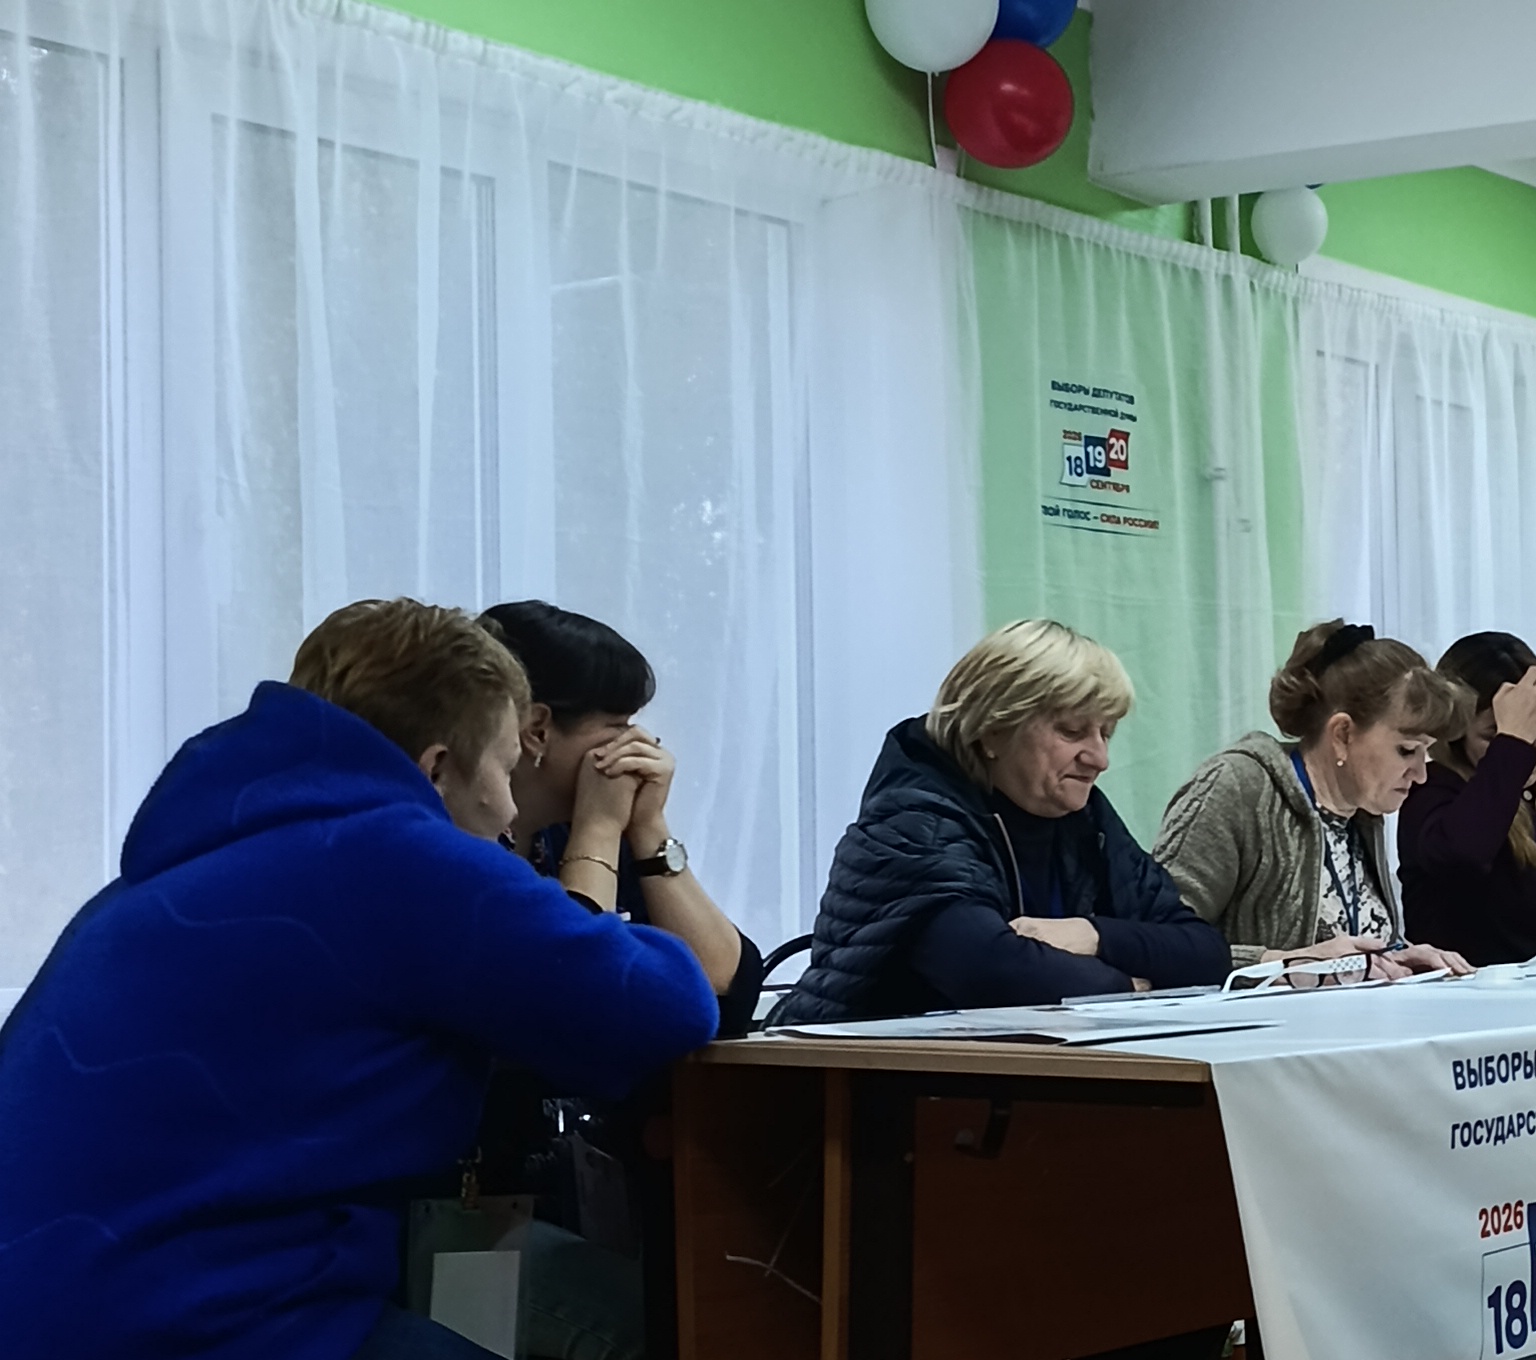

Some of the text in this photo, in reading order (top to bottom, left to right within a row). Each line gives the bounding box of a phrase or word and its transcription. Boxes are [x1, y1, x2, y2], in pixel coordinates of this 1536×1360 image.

[1066, 437, 1127, 477] 18 19 20
[1478, 1199, 1525, 1240] 2026
[1486, 1278, 1528, 1355] 18
